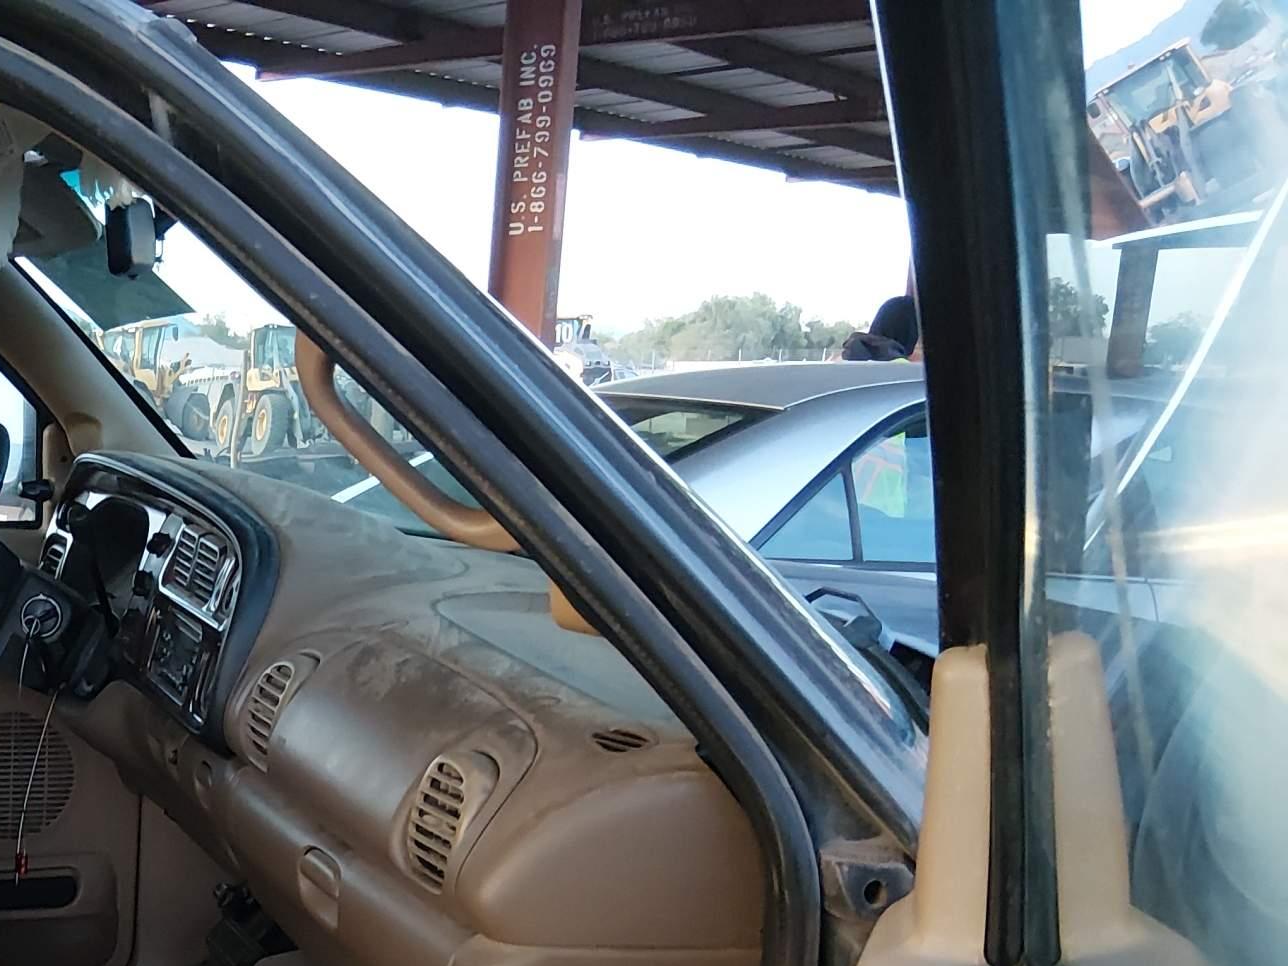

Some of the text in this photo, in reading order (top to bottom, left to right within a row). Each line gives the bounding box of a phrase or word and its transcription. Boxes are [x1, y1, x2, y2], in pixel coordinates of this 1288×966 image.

[509, 44, 539, 236] U.S. PREFAB INC.
[527, 44, 556, 232] 1-866-799-0969
